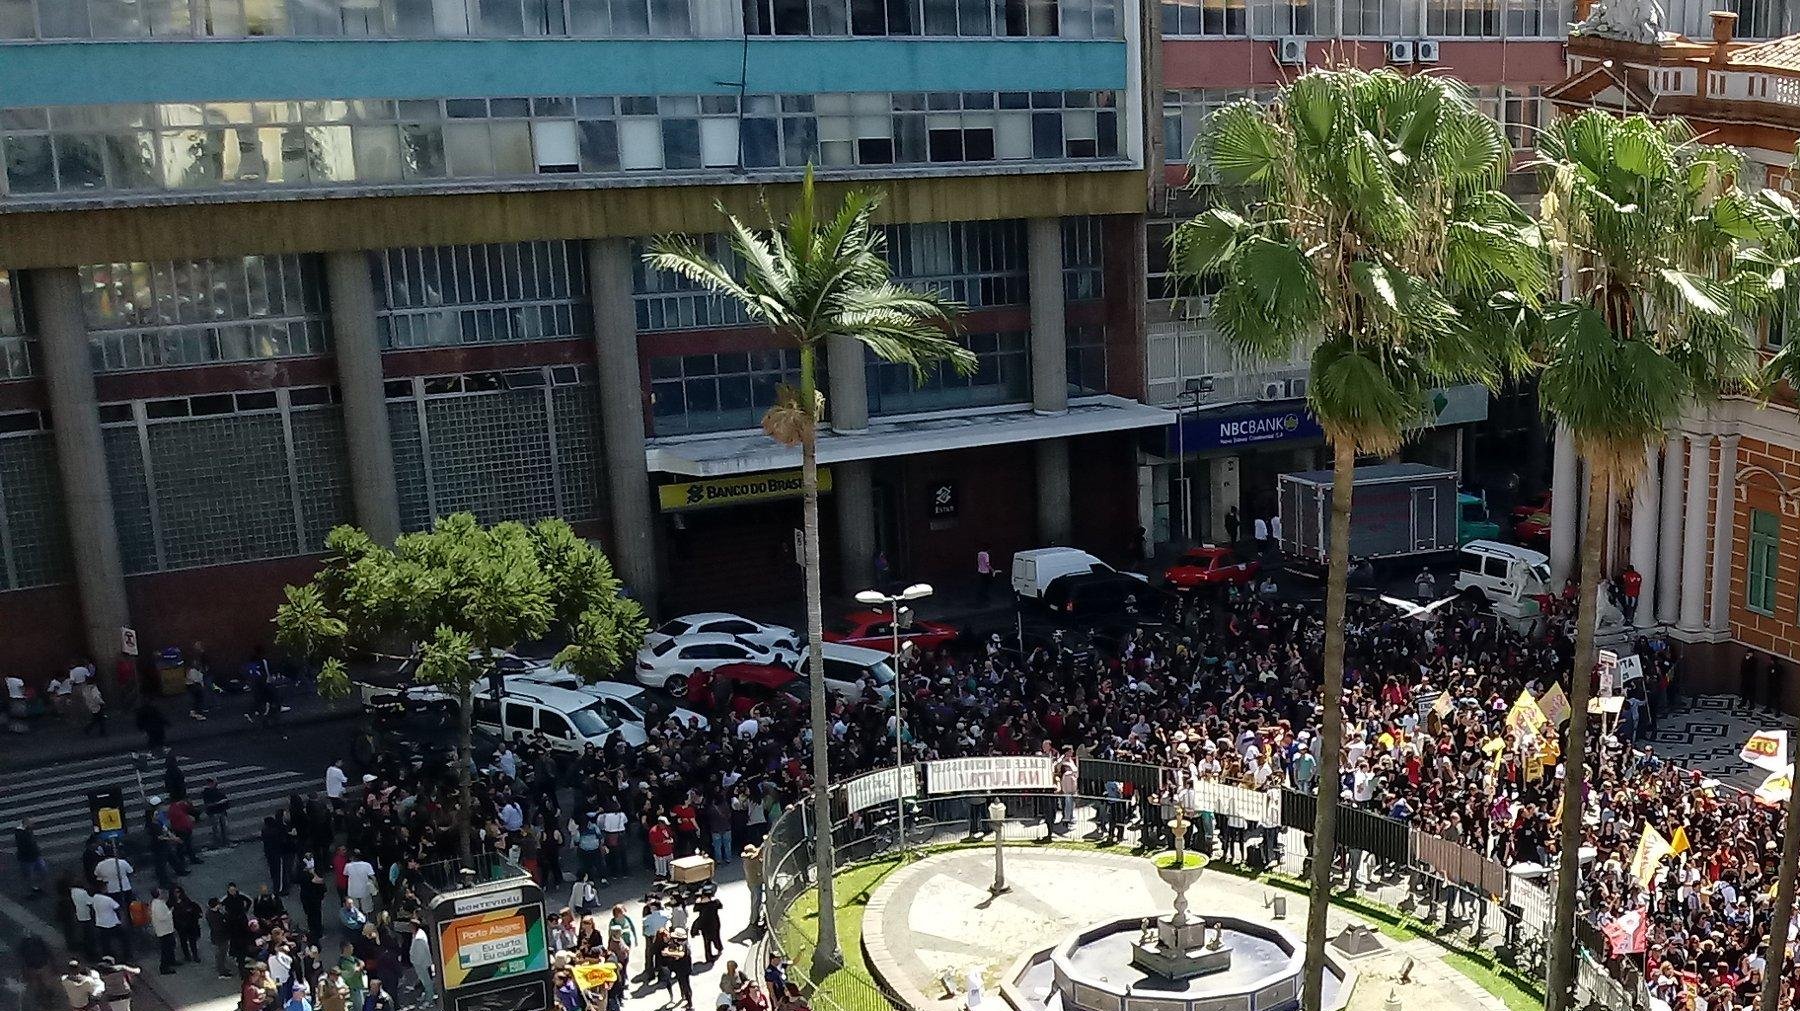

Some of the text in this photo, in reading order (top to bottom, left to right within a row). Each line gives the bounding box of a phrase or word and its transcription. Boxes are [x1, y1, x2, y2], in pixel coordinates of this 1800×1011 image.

[1220, 416, 1284, 437] NBCBANK
[706, 482, 748, 499] BANCO
[768, 478, 803, 493] BRASI
